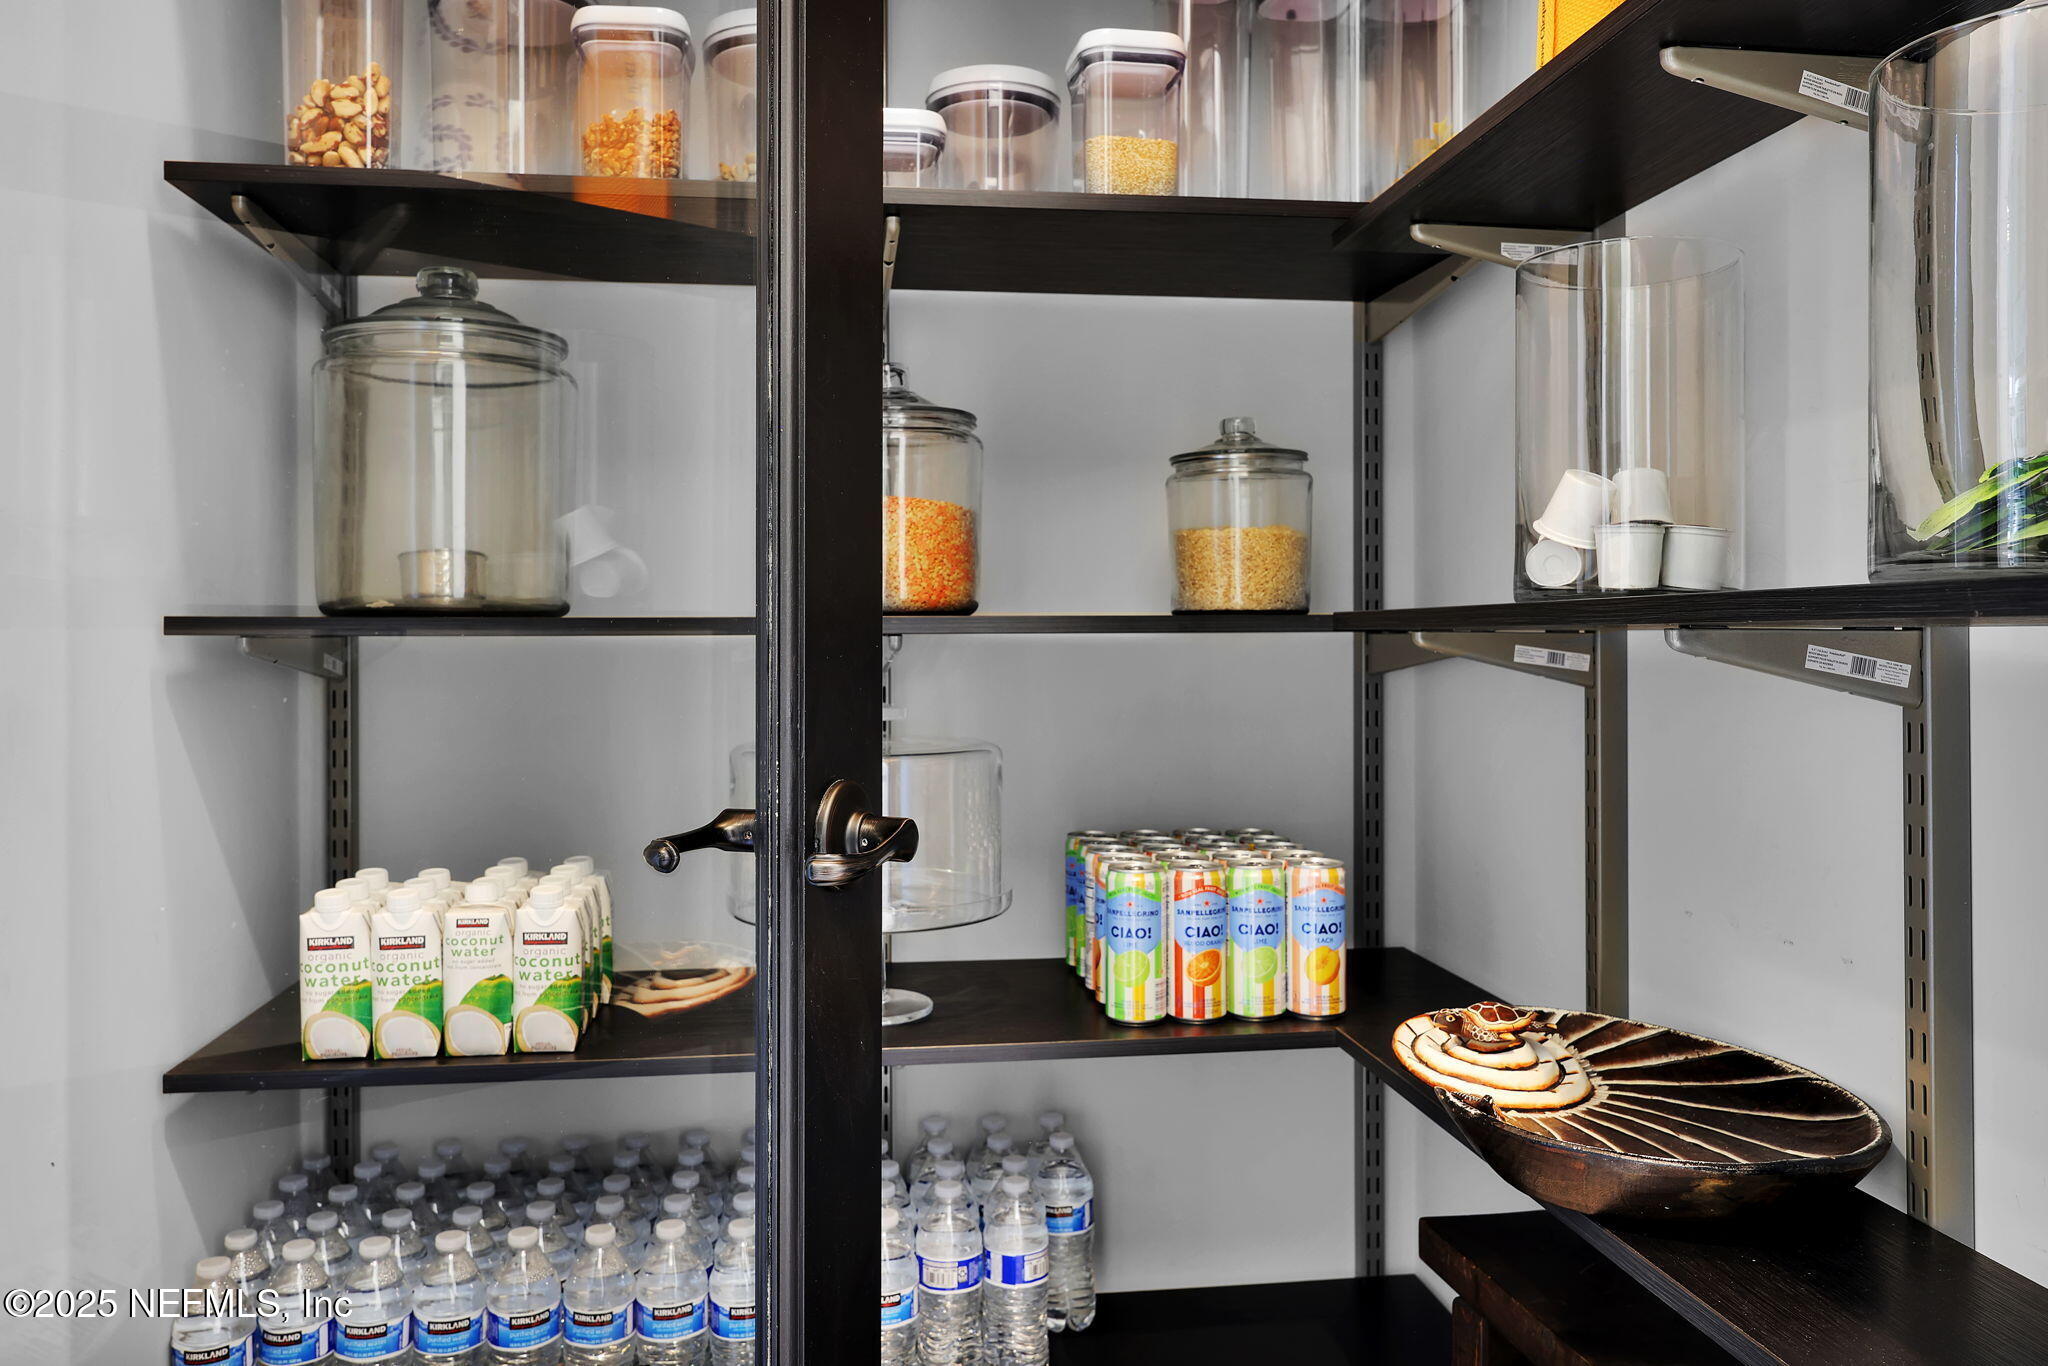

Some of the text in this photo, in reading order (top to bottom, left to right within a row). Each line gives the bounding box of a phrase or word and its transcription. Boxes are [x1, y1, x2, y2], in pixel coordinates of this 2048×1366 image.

[455, 929, 491, 937] organic
[1111, 925, 1152, 939] CIAO!
[1184, 924, 1223, 938] CIAO!
[1238, 920, 1279, 936] CIAO!
[1301, 922, 1342, 935] CIAO!
[309, 937, 353, 947] KIRKLAND
[381, 937, 425, 946] KIRKLAND
[524, 933, 567, 941] KIRKLAND
[307, 952, 352, 962] organic
[379, 952, 424, 962] organic
[451, 948, 496, 957] water
[523, 947, 567, 958] organic
[376, 974, 432, 987] water
[519, 969, 573, 981] water
[304, 974, 361, 988] water
[881, 1295, 900, 1304] LAND
[654, 1304, 692, 1317] KIRKLAND
[730, 1306, 756, 1316] KIRKL
[511, 1311, 550, 1325] KIRKLAND
[574, 1313, 612, 1323] KIRKLAND
[346, 1325, 387, 1336] KIRKLAND
[429, 1320, 470, 1331] KIRKLAND
[186, 1348, 229, 1361] KIRKLAND
